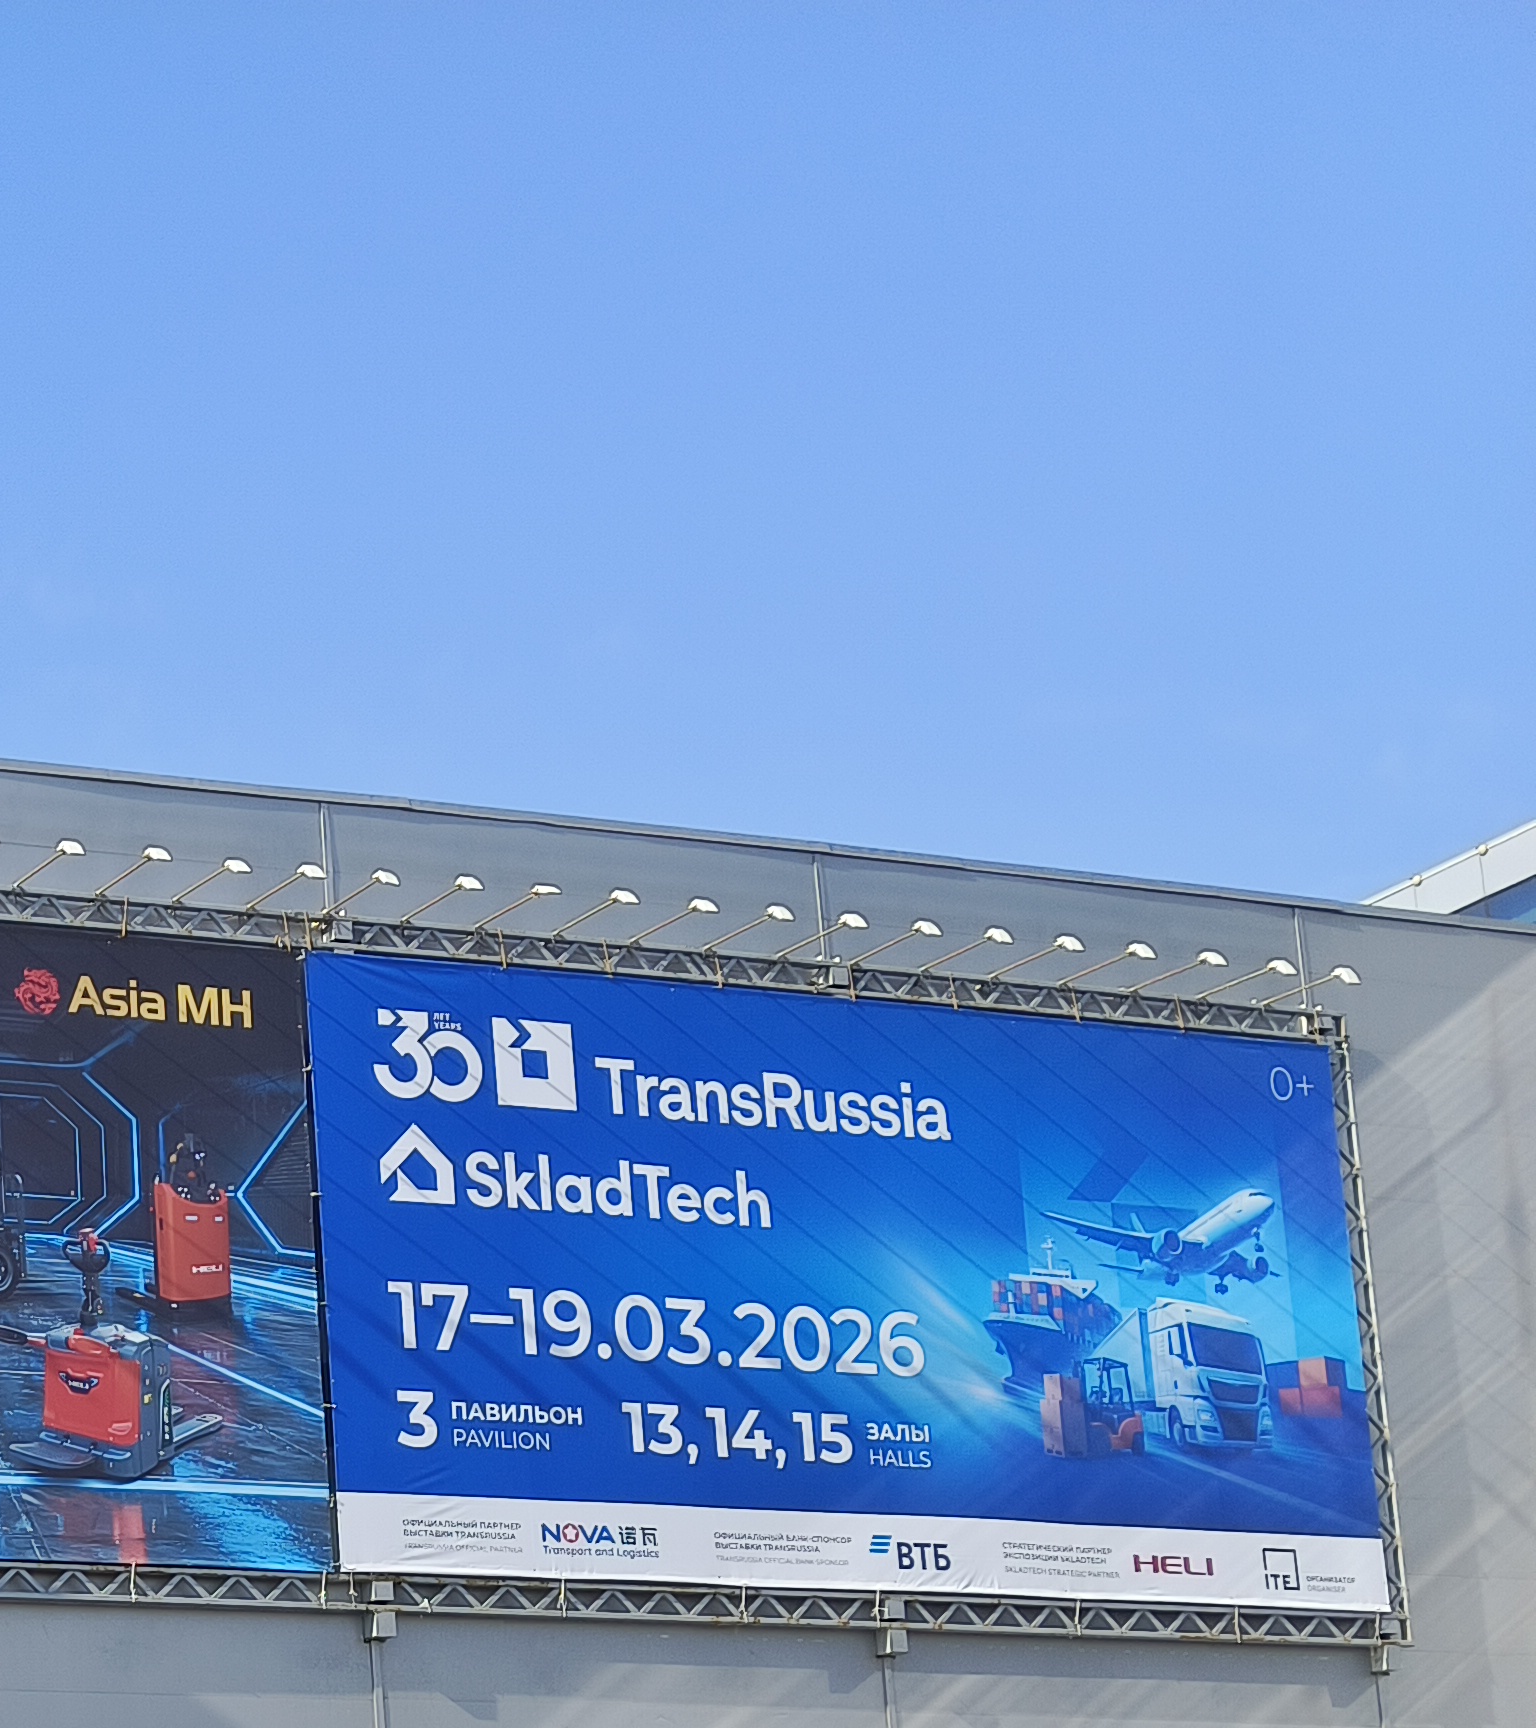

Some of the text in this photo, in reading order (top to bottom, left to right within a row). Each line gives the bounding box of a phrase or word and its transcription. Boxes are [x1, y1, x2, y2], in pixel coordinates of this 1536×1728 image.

[68, 975, 254, 1029] Asia MH
[595, 1056, 952, 1142] TransRussia
[1270, 1066, 1315, 1102] 0+
[465, 1151, 772, 1229] SkladTech
[396, 1390, 439, 1449] 3
[451, 1400, 583, 1427] ПАВИЛЬОН
[865, 1421, 930, 1445] ЗАЛЫ
[453, 1427, 932, 1469] PAVILION HALLS
[541, 1523, 616, 1544] NOVA
[542, 1545, 592, 1558] Transport
[595, 1547, 614, 1557] and
[896, 1541, 952, 1571] ВТБ
[1133, 1553, 1214, 1577] HELI
[1265, 1573, 1292, 1591] ITE
